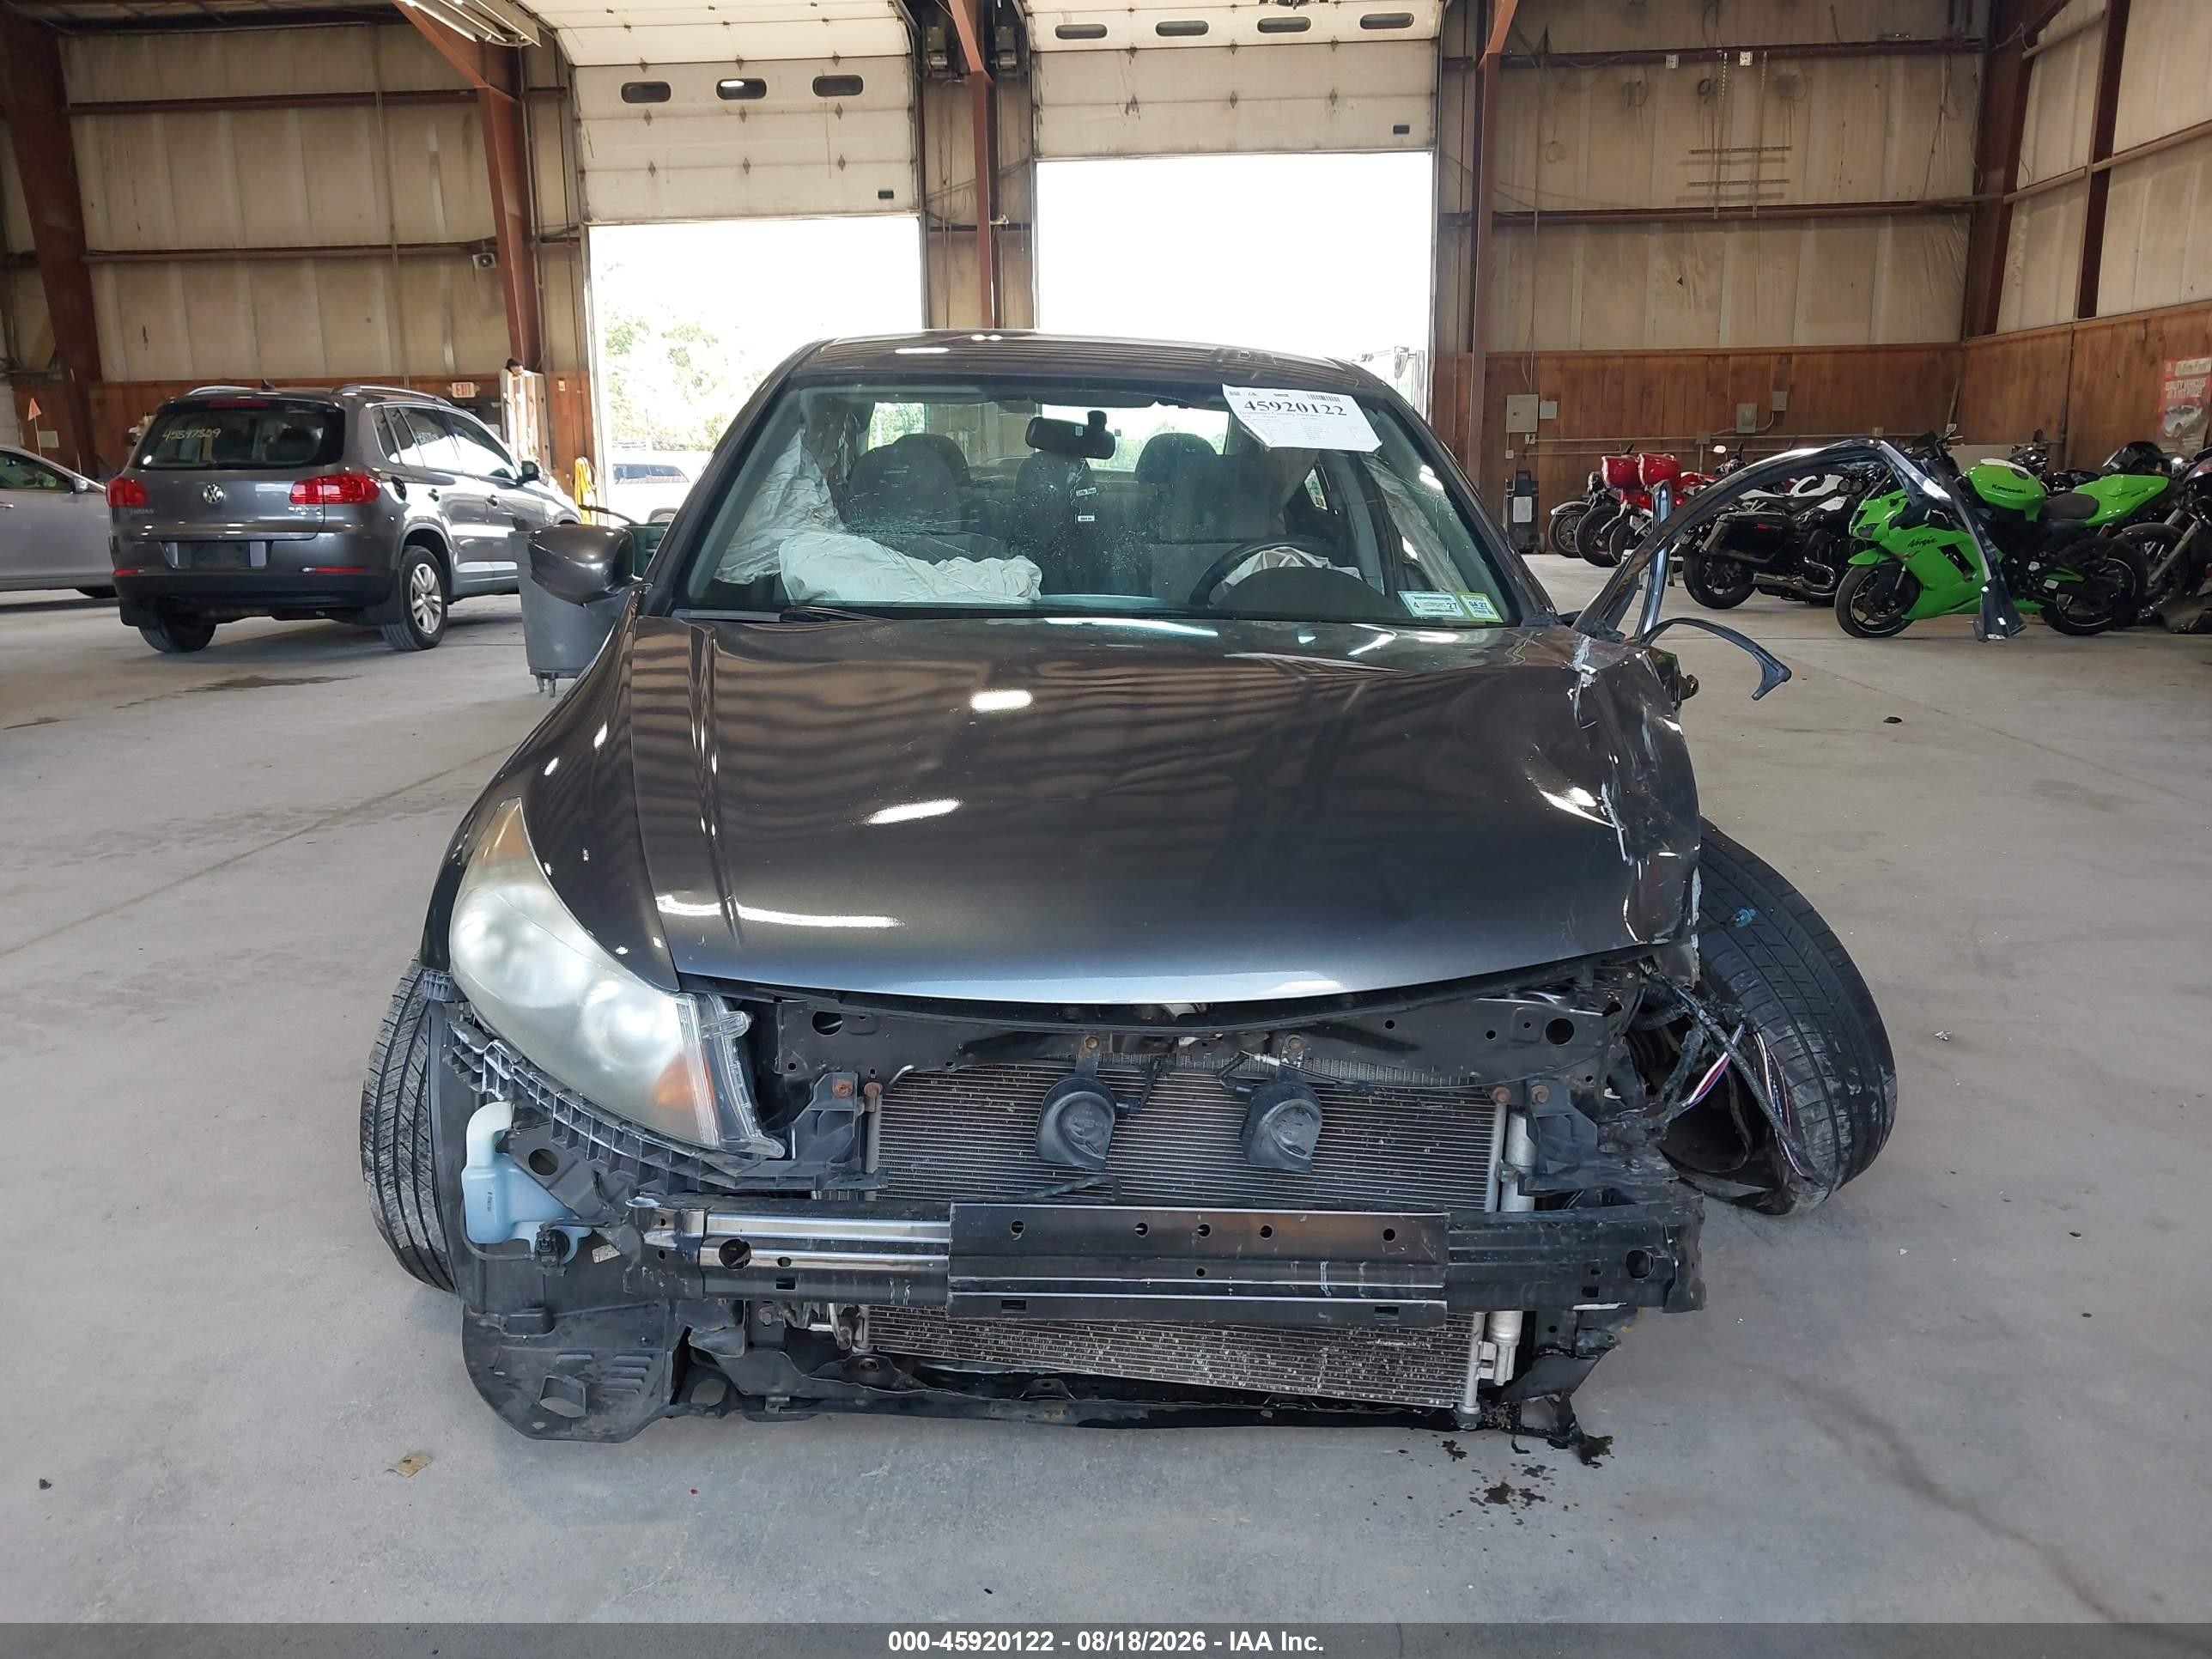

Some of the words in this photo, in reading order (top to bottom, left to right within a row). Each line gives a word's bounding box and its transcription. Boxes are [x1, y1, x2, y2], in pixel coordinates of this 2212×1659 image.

[456, 383, 471, 396] EXIT
[1244, 400, 1347, 416] 45920122
[1992, 483, 2027, 494] Kawasaki
[1907, 536, 1937, 547] Ninja
